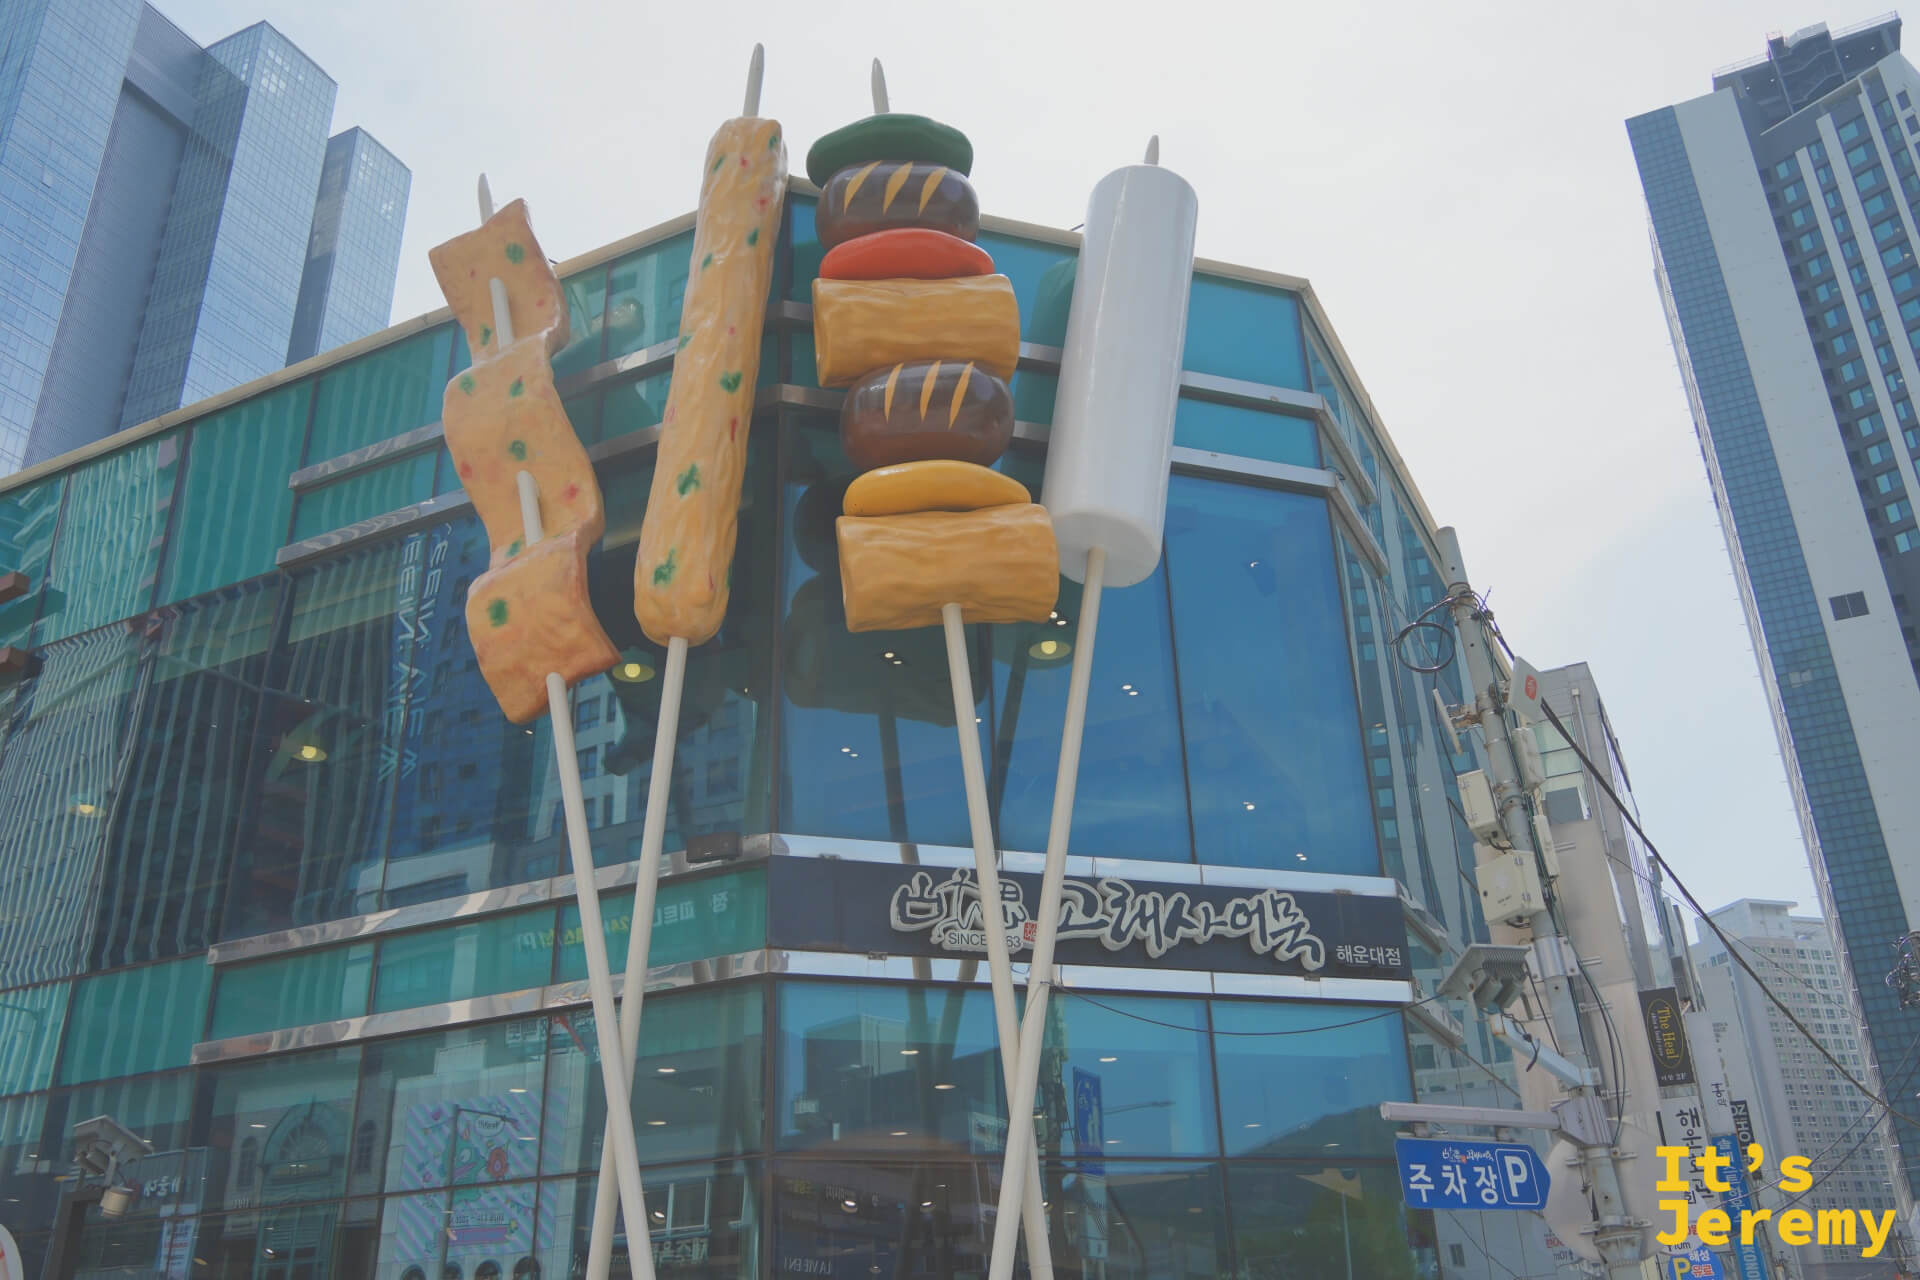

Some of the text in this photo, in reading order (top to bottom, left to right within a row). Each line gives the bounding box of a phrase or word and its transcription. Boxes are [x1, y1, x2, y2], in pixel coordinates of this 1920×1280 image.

[949, 932, 987, 946] SINCE
[1336, 943, 1402, 966] 해운대점
[1656, 1006, 1672, 1031] The
[1662, 1031, 1680, 1060] Heal
[1409, 1163, 1499, 1204] 주차장
[1504, 1155, 1528, 1198] P
[1688, 1249, 1711, 1262] 해성
[1673, 1257, 1691, 1280] P
[1692, 1264, 1715, 1278] 유료
